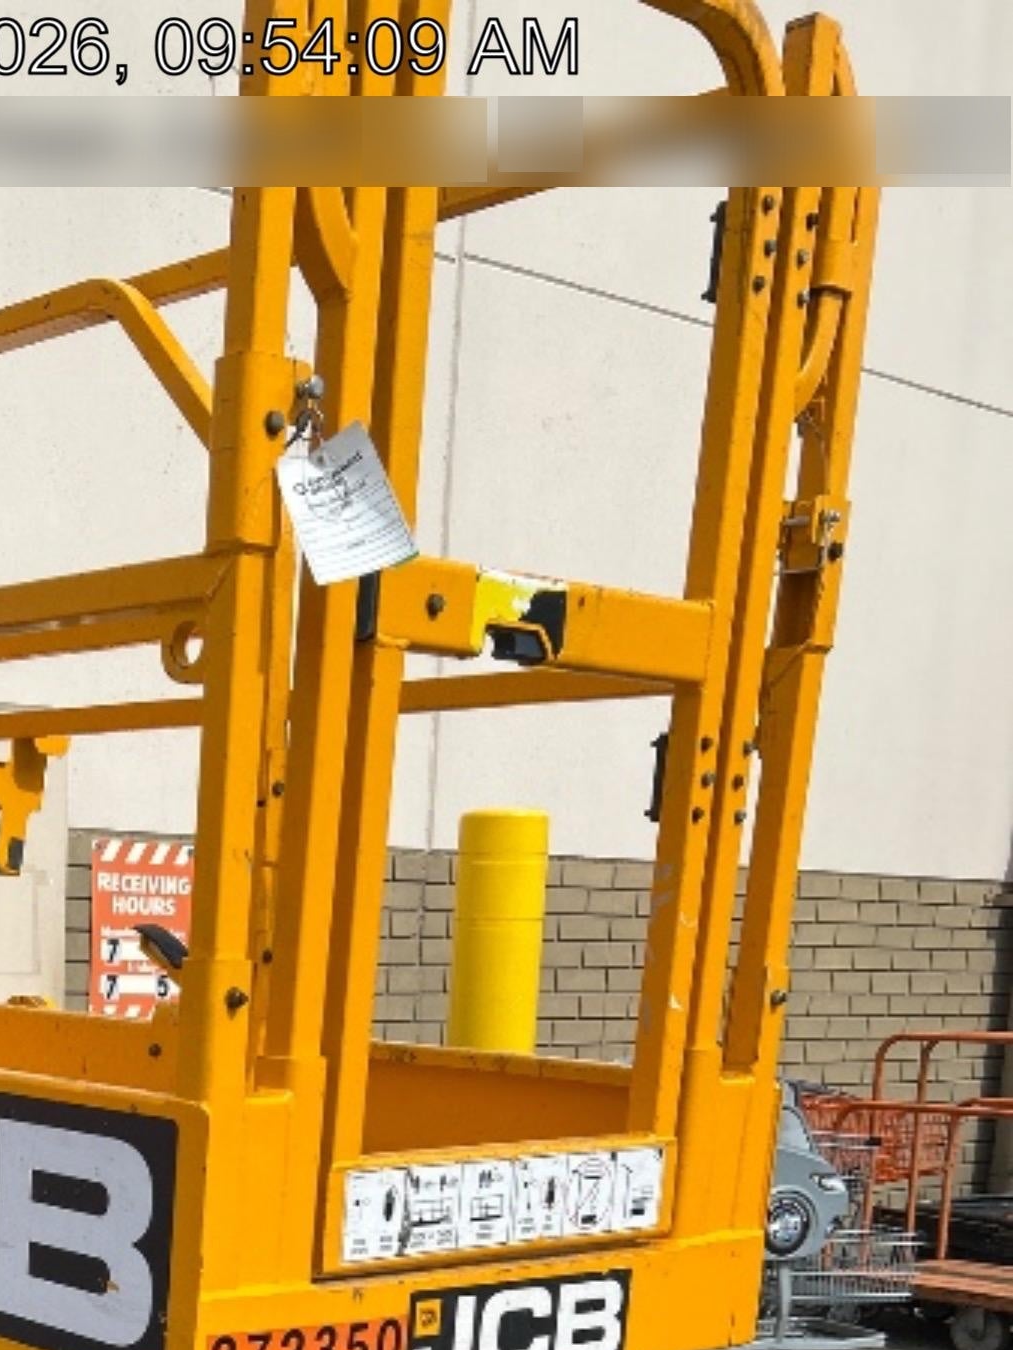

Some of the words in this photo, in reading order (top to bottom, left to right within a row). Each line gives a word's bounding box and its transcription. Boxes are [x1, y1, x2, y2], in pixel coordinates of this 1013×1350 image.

[97, 873, 191, 895] RECEIVING
[111, 895, 177, 916] HOURS
[106, 939, 119, 962] 7
[106, 975, 118, 998] 7
[157, 975, 169, 997] 5
